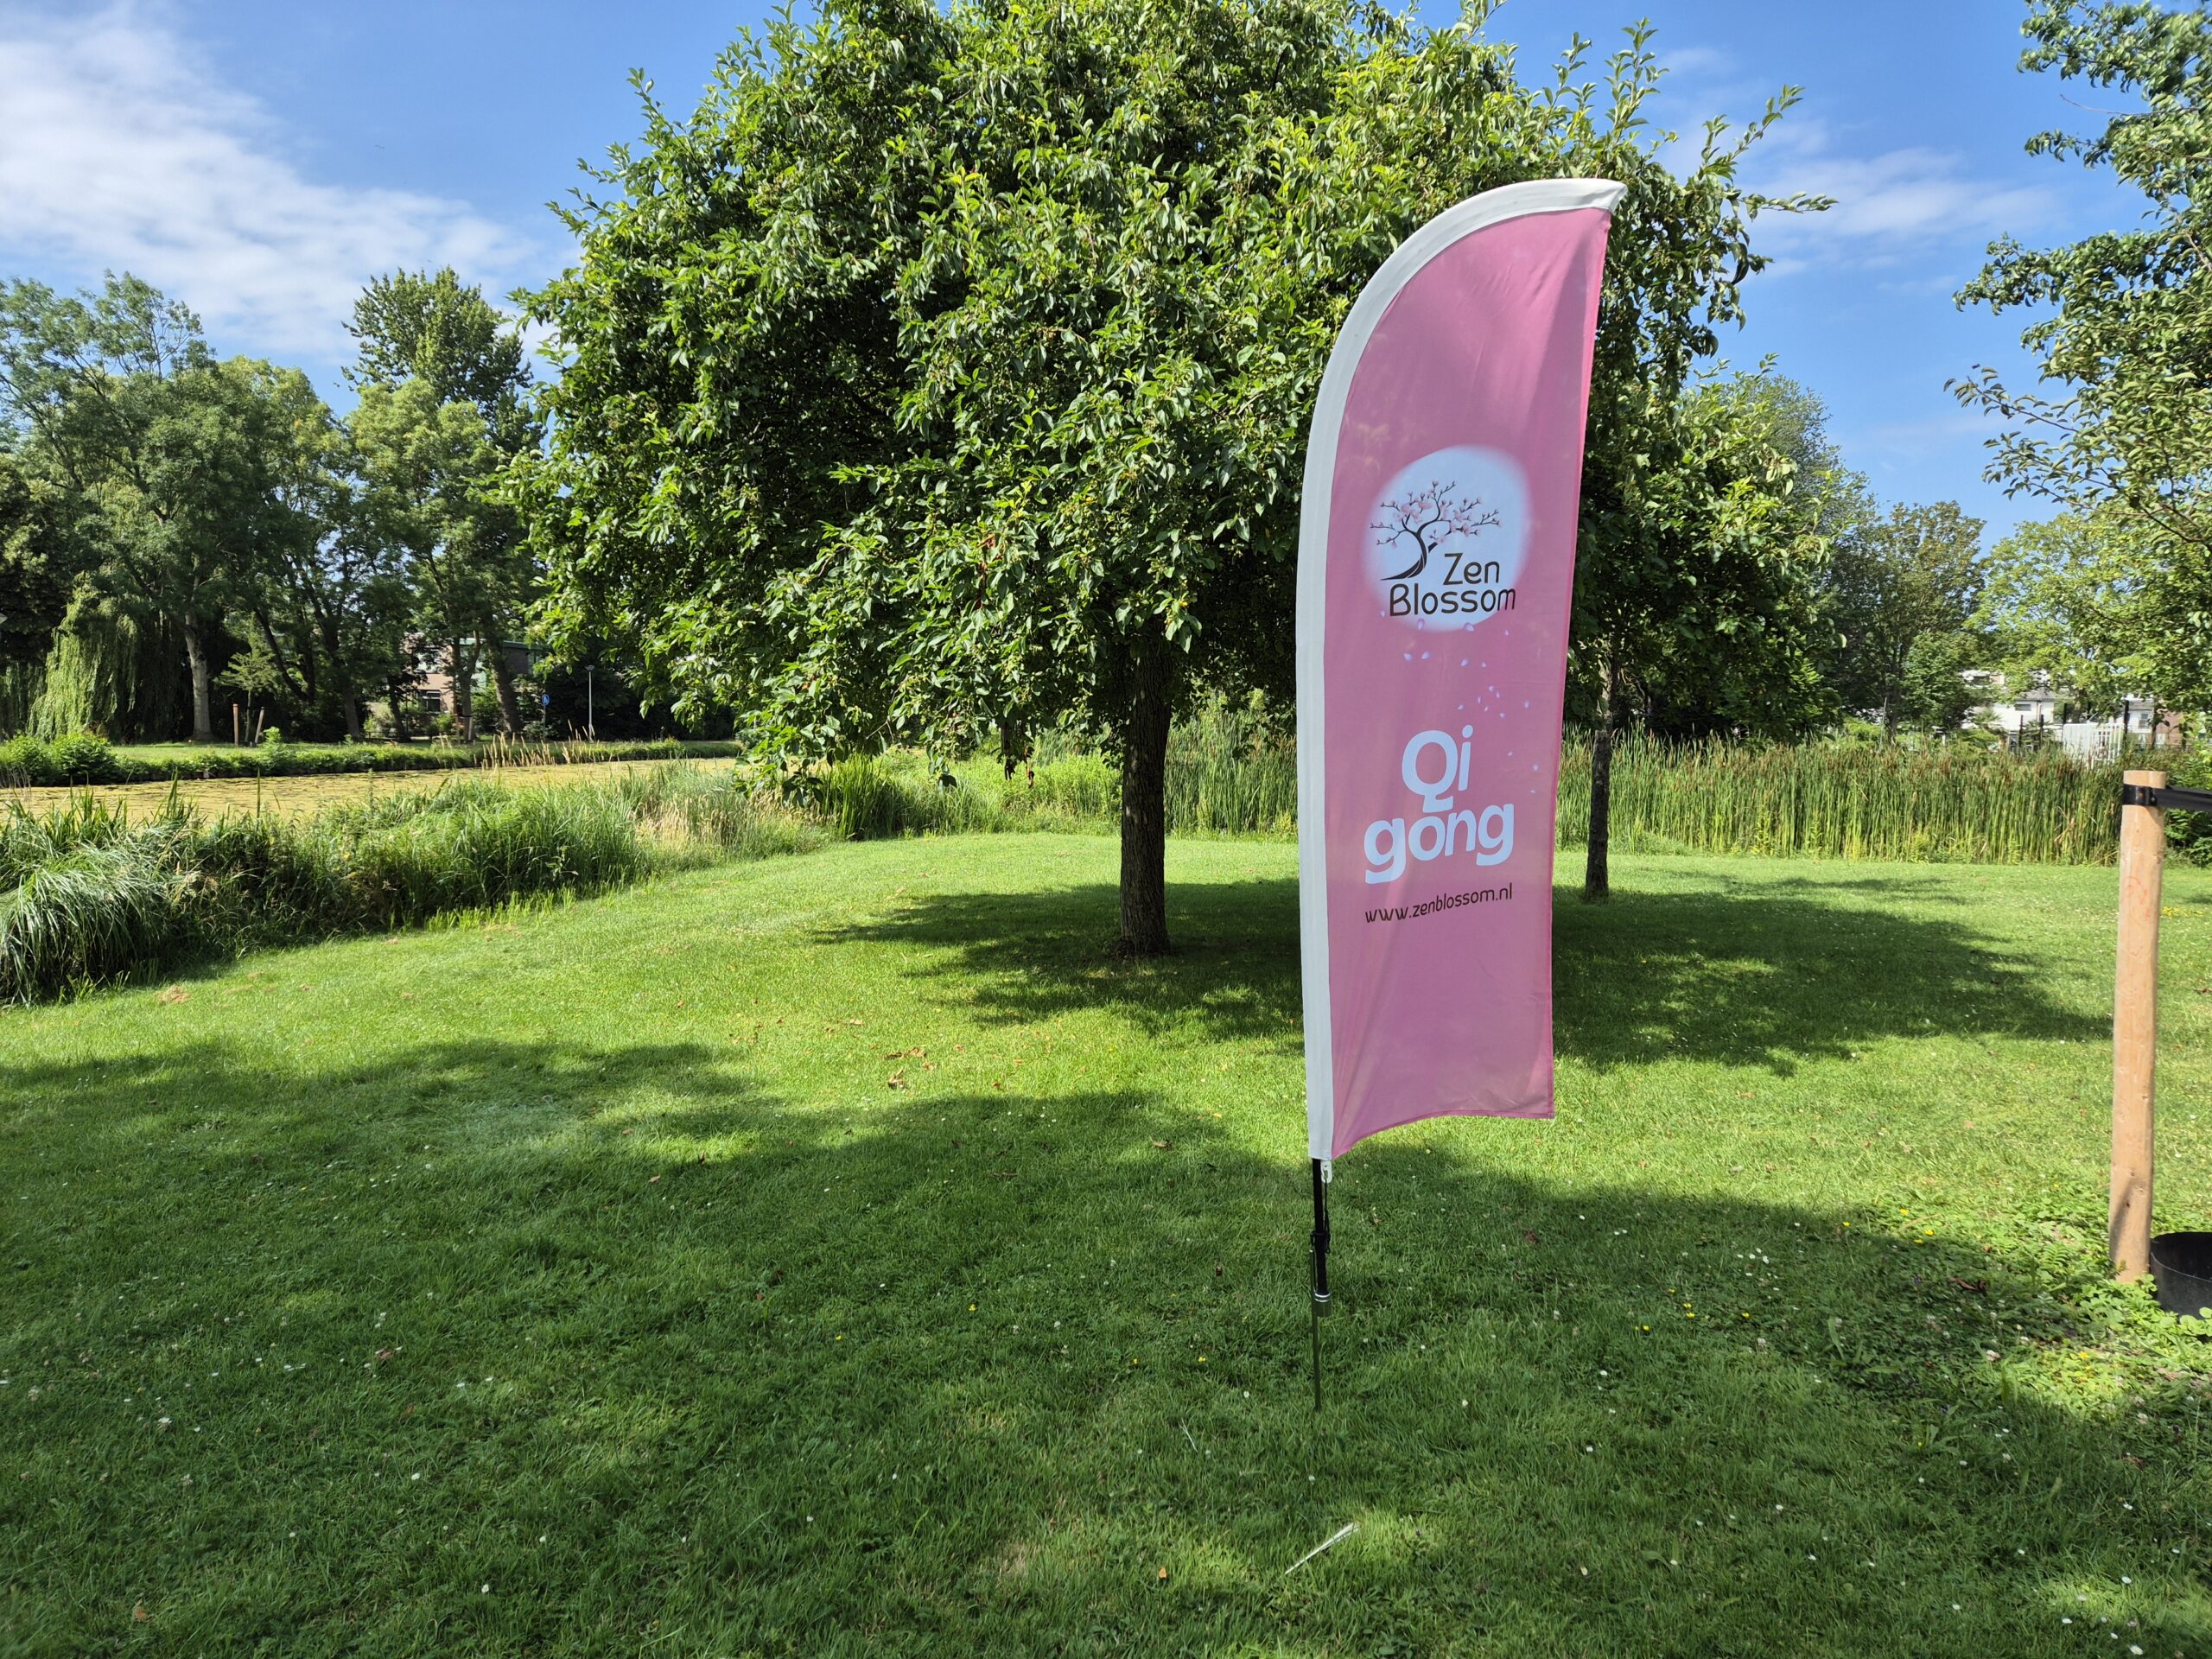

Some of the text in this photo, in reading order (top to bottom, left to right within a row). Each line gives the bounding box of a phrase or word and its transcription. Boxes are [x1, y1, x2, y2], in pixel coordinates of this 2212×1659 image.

[1442, 552, 1500, 586] Zen
[1389, 582, 1516, 617] Blossom
[1402, 724, 1474, 813] Qi
[1363, 803, 1515, 885] gong
[1364, 882, 1513, 924] www.zenblossom.nl
